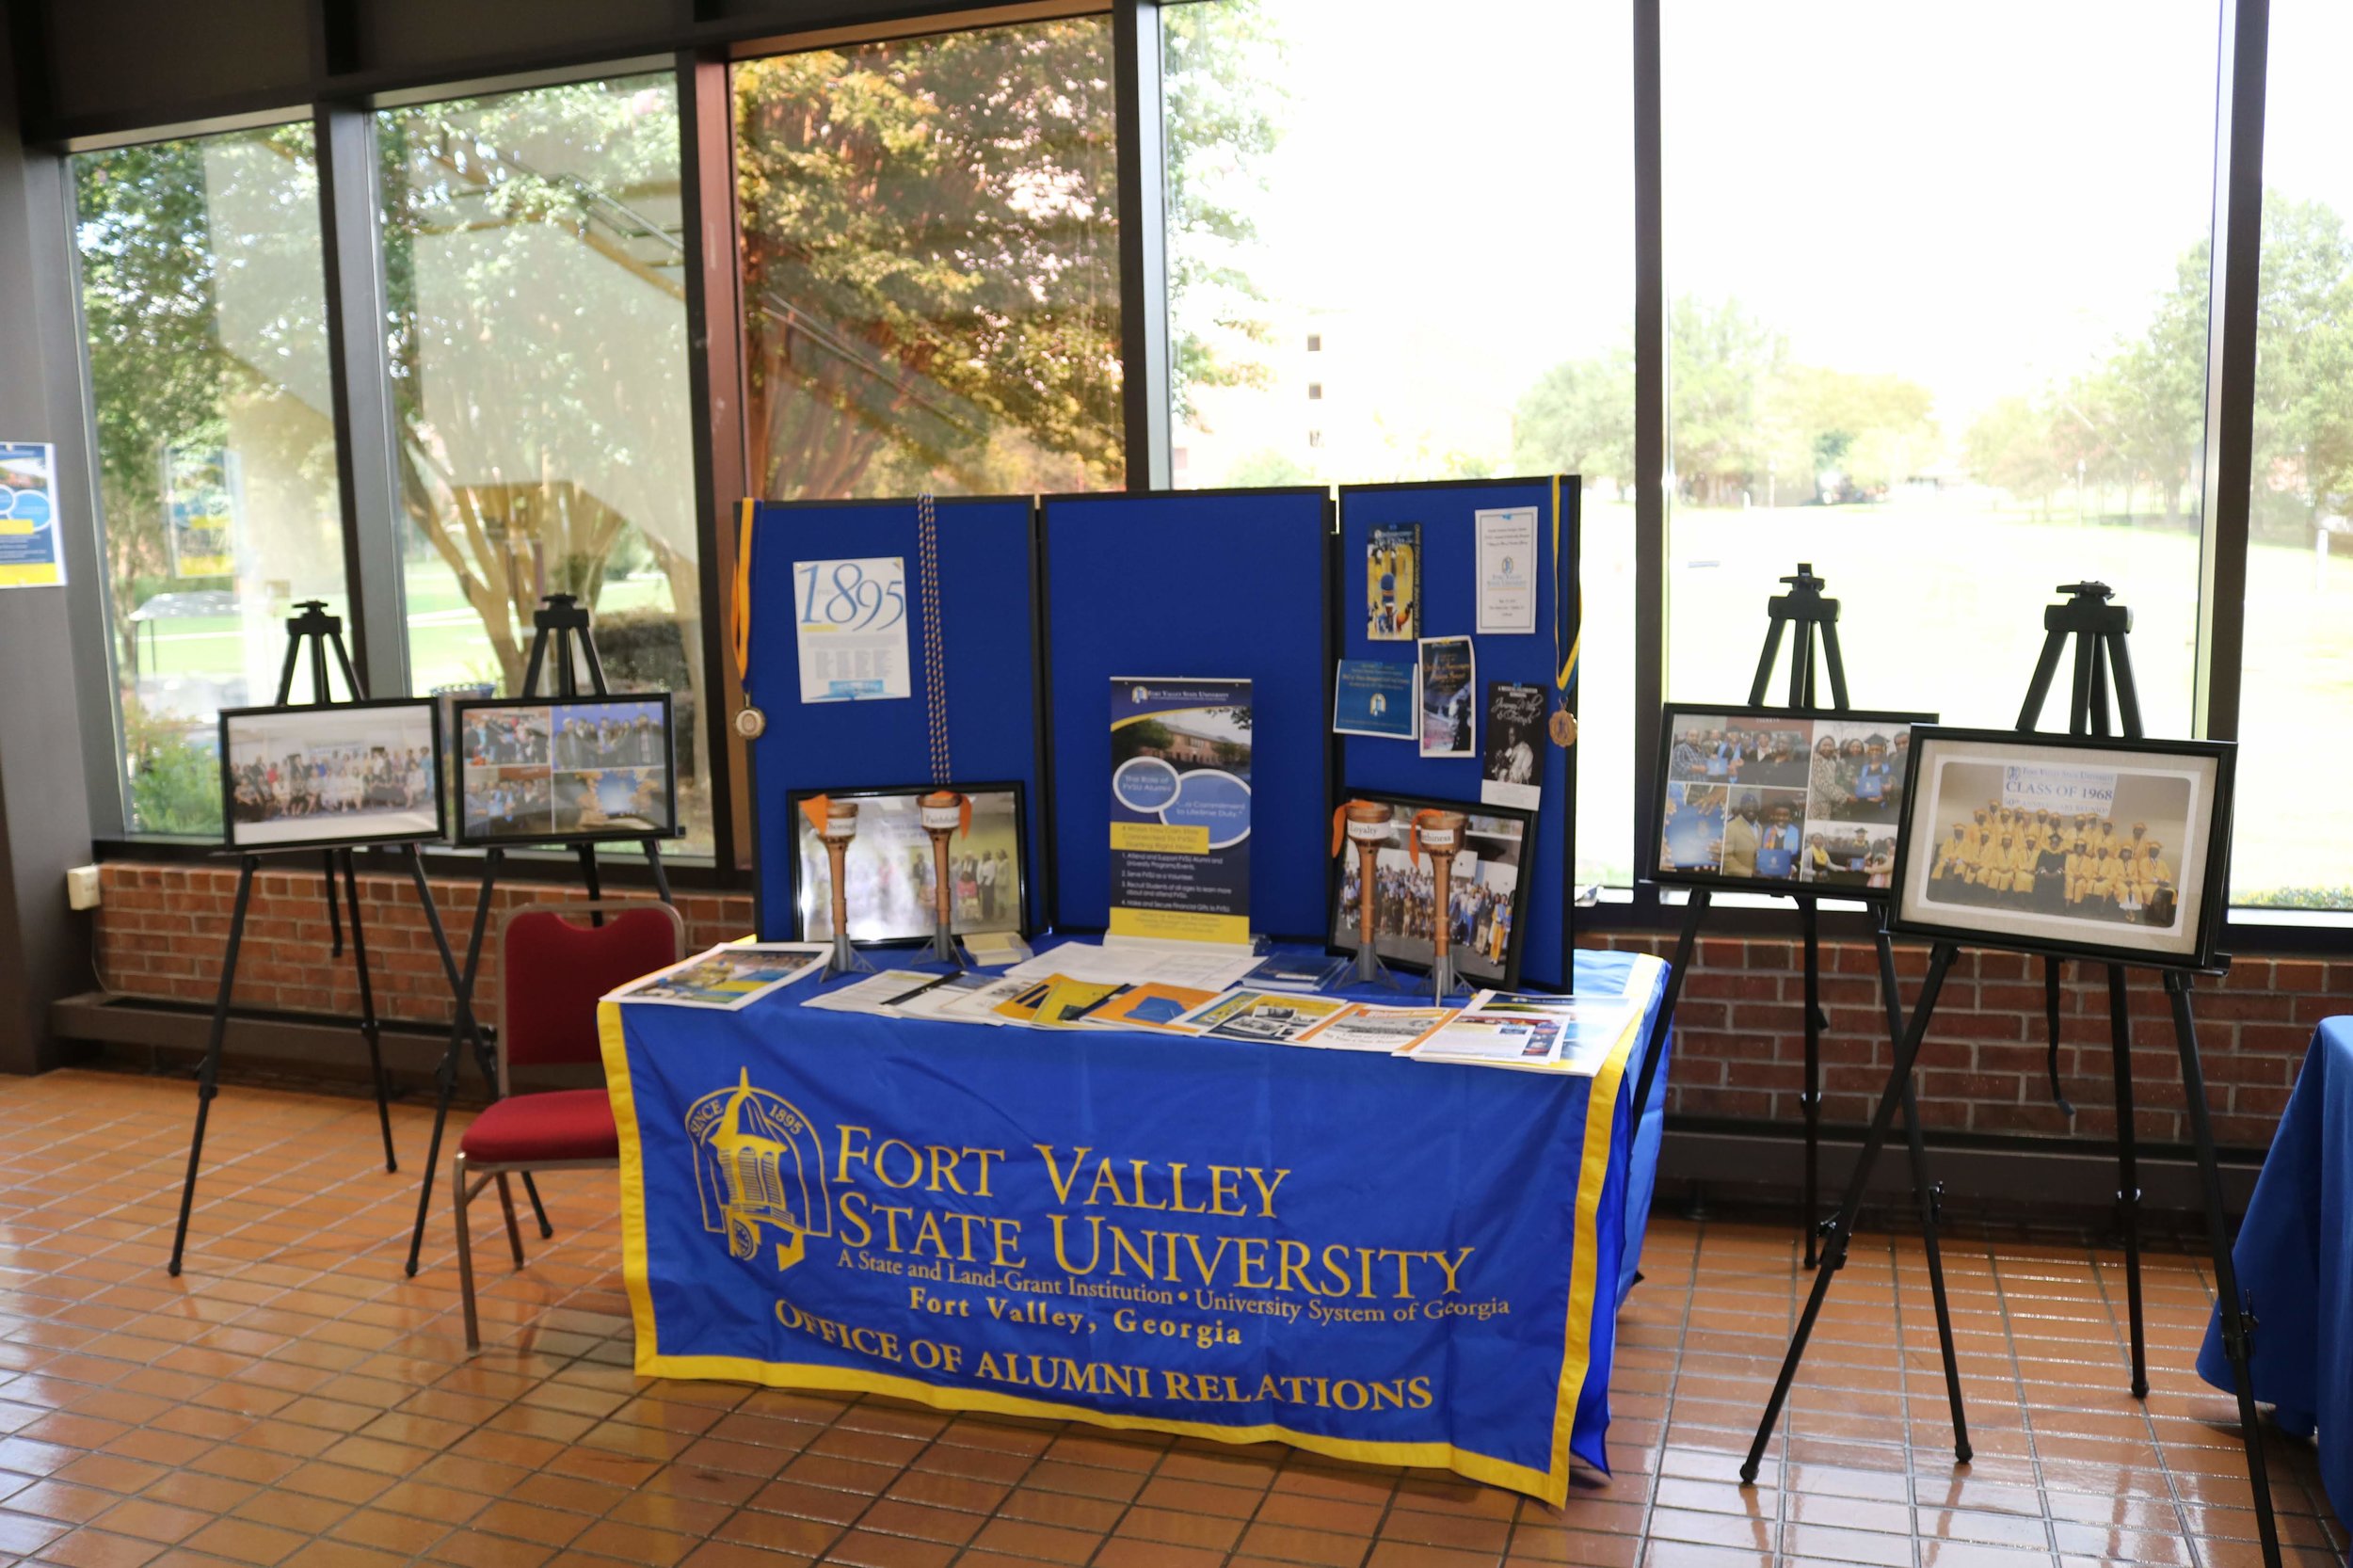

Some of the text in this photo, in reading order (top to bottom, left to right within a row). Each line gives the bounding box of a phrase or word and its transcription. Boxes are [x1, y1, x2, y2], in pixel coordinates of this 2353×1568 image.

[798, 563, 904, 632] 1895
[2006, 781, 2113, 801] CLASS OF 1968
[1350, 824, 1377, 837] Loyalty
[690, 1099, 724, 1138] SINCE
[769, 1103, 804, 1135] 1895
[832, 1124, 1291, 1219] FORT VALLEY
[839, 1192, 1476, 1299] STATE UNIVERSITY
[837, 1248, 1511, 1327] A State and Land-Grant Institution University System of Georgia
[909, 1286, 1242, 1349] Fort Valley, Georgia
[775, 1299, 1433, 1411] OFFICE OF ALUMNI RELATIONS
